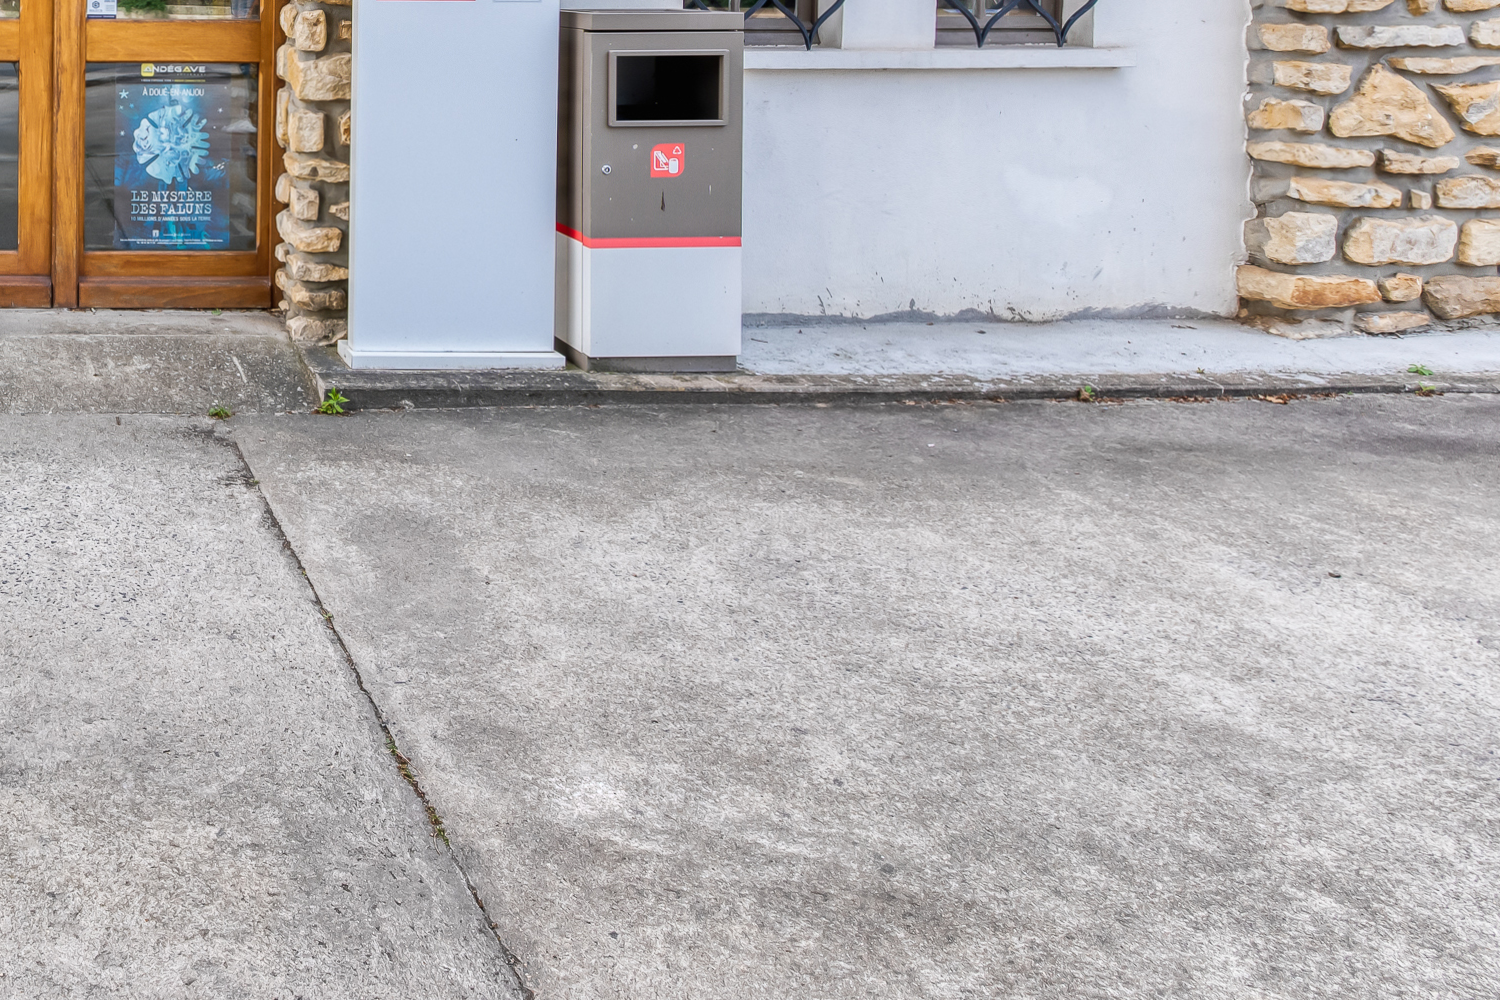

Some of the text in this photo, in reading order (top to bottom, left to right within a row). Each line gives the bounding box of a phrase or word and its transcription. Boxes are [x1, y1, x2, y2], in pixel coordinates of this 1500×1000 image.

[142, 86, 205, 97] À DOUÉ-EN-ANJOU
[130, 187, 212, 202] LE MYSTÈRE
[130, 204, 212, 214] DES FALUNS
